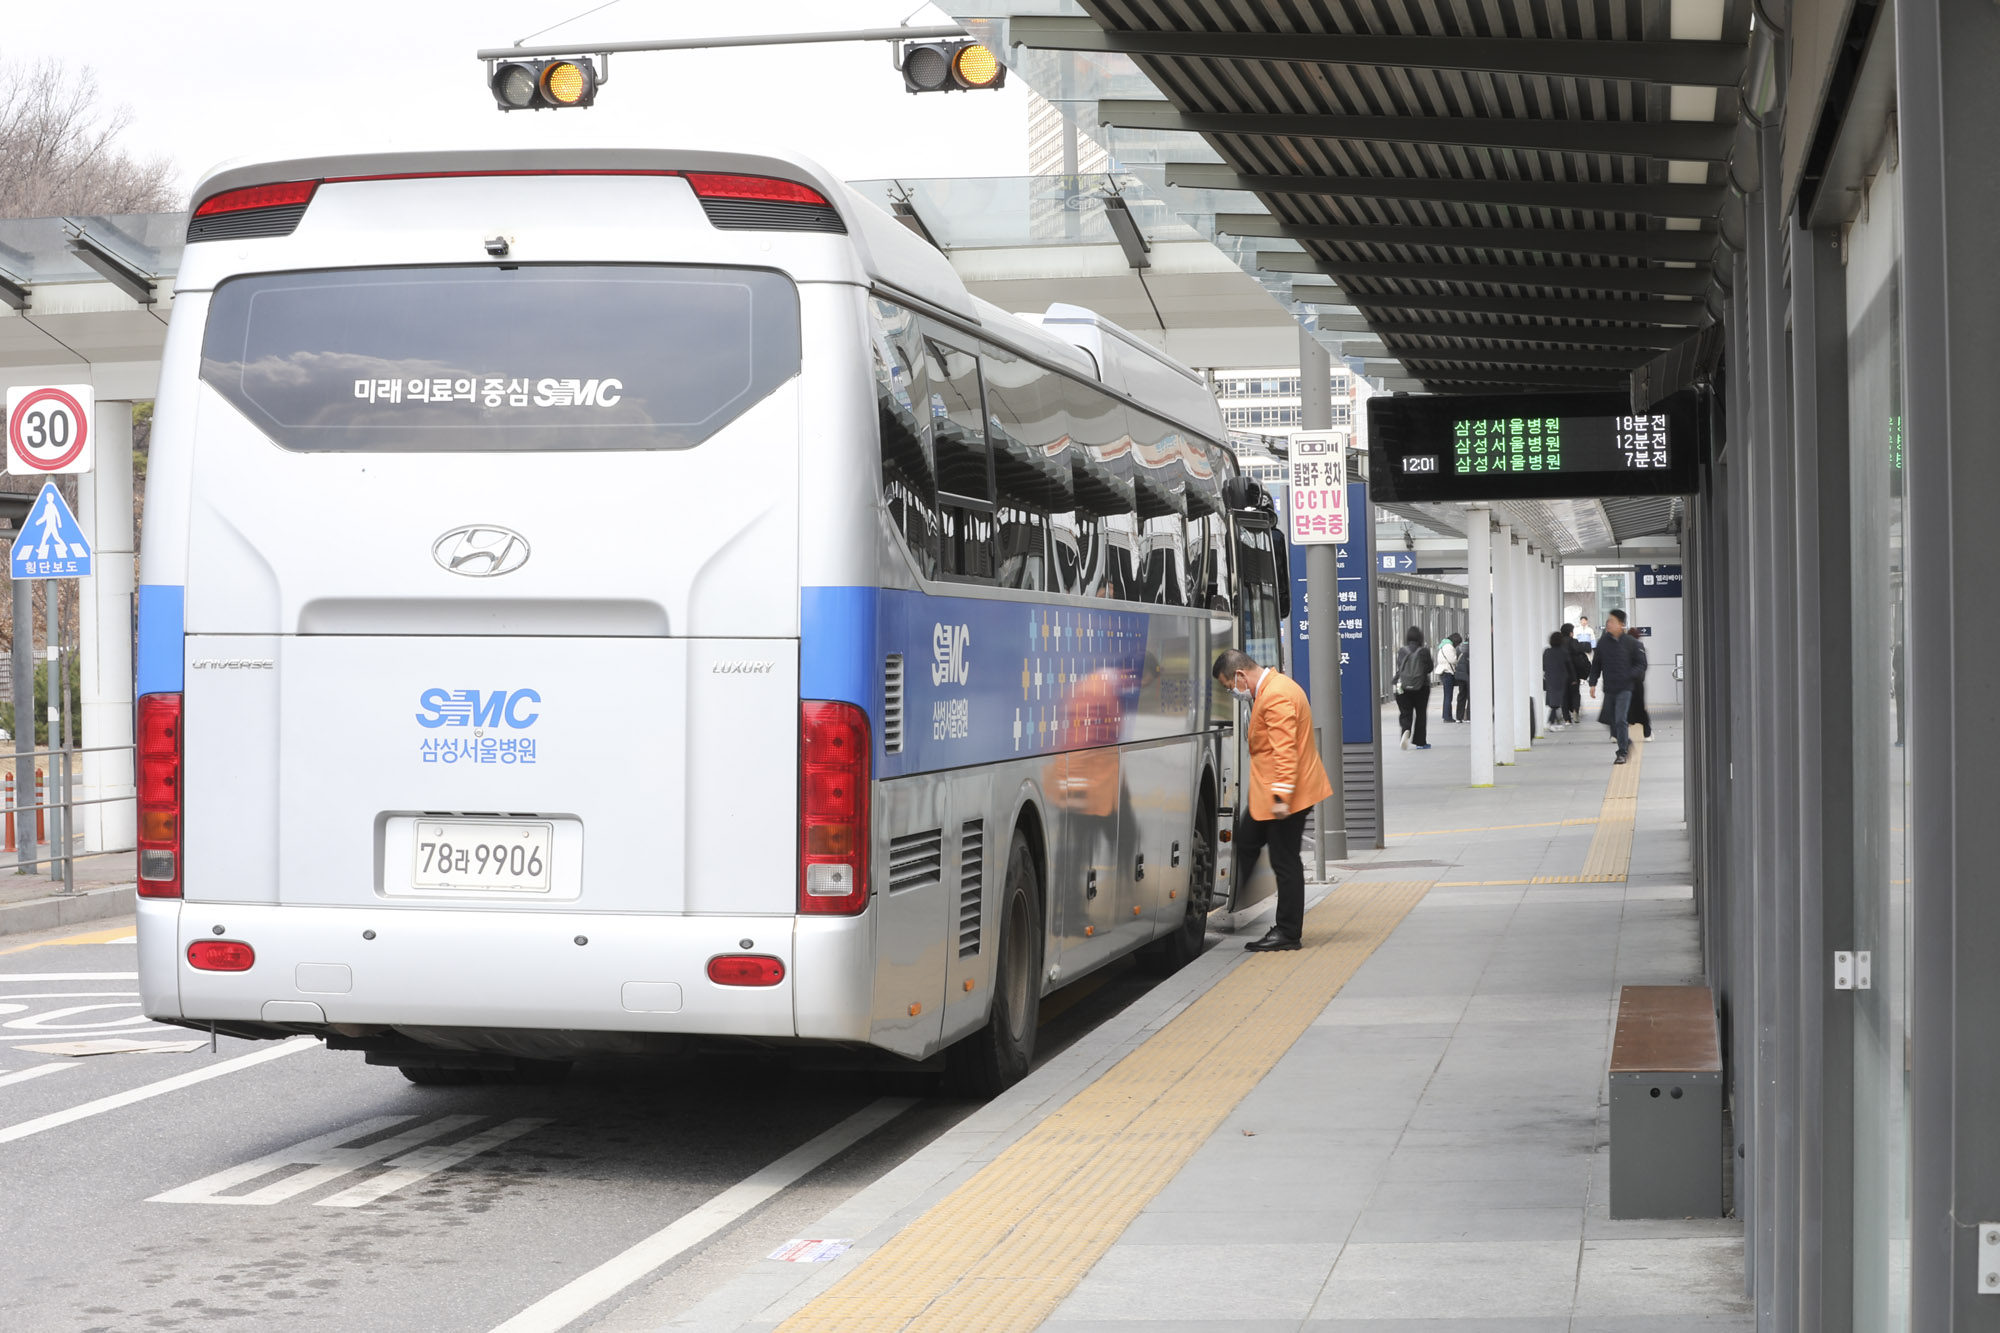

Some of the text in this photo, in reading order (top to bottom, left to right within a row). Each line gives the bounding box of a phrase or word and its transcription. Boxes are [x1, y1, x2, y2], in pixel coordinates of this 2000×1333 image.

[354, 378, 623, 408] 미래 의료의 중심 SMC
[26, 410, 69, 449] 30
[1454, 414, 1666, 437] 삼성서울병원 18분전
[1455, 432, 1667, 455] 삼성서울병원 12분전
[1402, 457, 1435, 472] 12:01
[1455, 450, 1668, 473] 삼성서울병원 7분전
[1294, 489, 1342, 510] CCTV
[1295, 514, 1343, 536] 단속중
[24, 561, 79, 575] 횡단보도
[192, 658, 275, 670] UNIVERSE
[931, 621, 970, 687] SMC
[712, 659, 775, 674] LUXURY
[415, 687, 542, 729] SMC
[932, 698, 969, 741] 삼성서울병원
[420, 737, 537, 765] 삼성서울병원
